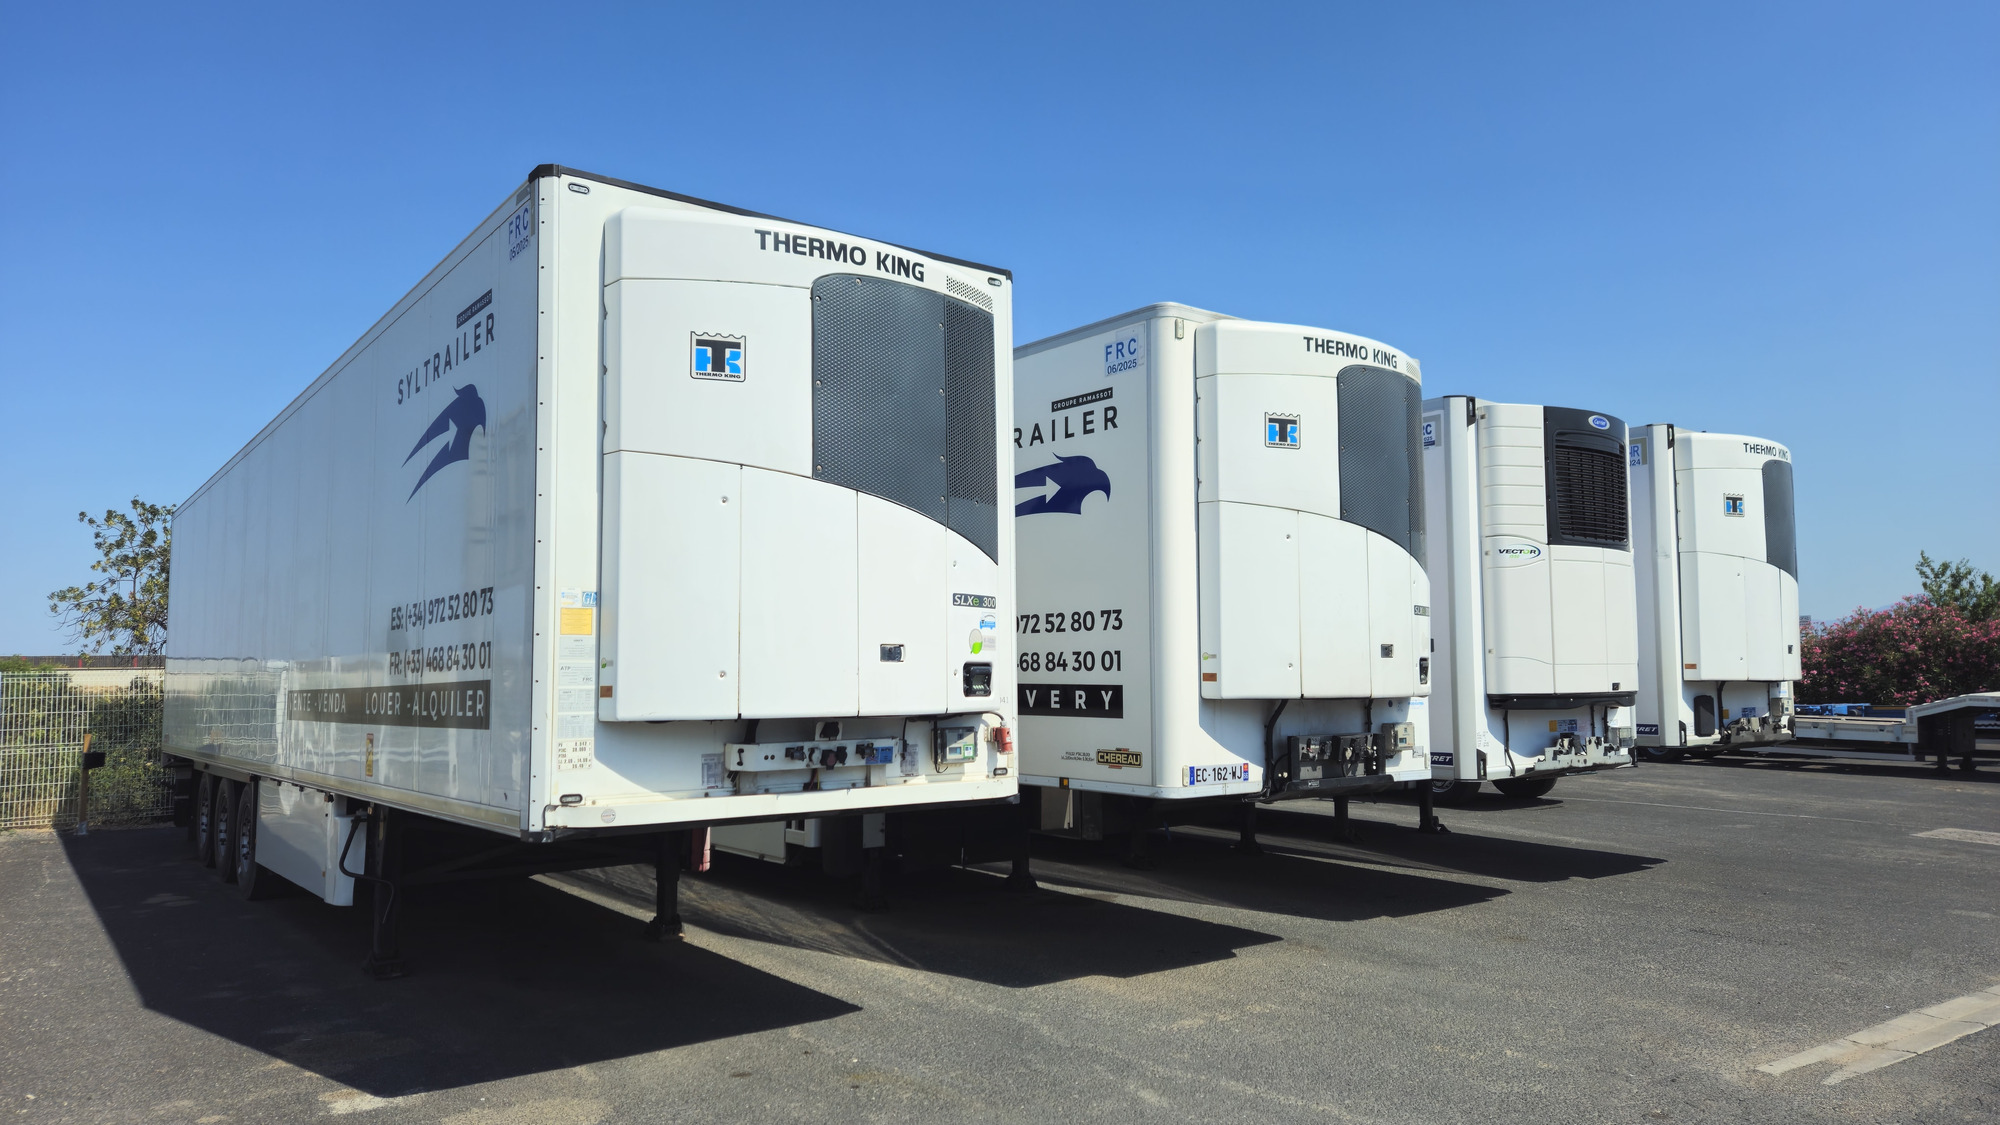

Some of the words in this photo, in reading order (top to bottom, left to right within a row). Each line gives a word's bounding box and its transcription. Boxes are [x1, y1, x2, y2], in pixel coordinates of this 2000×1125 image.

[508, 207, 529, 245] FRC
[754, 228, 867, 266] THERMO
[876, 251, 925, 283] KING
[397, 312, 495, 405] SYLTRAILER
[1104, 337, 1138, 362] FRC
[1303, 336, 1368, 360] THERMO
[1373, 348, 1398, 369] KING
[1106, 358, 1138, 375] 06/2025
[1053, 398, 1077, 410] GROUPE
[1079, 390, 1112, 404] RAMASSOT
[1743, 442, 1777, 457] THERMO
[1778, 448, 1789, 461] KING
[390, 607, 404, 631] ES:
[405, 600, 426, 632] (+34)
[428, 597, 446, 624] 972
[447, 593, 460, 621] 52
[463, 590, 477, 619] 80
[480, 586, 493, 616] 73
[953, 594, 980, 606] SLXe
[982, 597, 996, 608] 300
[1016, 613, 1041, 634] 72
[1044, 612, 1066, 633] 52
[1070, 610, 1095, 632] 80
[1100, 609, 1123, 631] 73
[389, 652, 403, 676] FR:
[404, 647, 424, 678] (+33)
[426, 646, 444, 673] 468
[446, 644, 460, 672] 84
[462, 642, 476, 671] 30
[479, 641, 491, 669] 01
[1016, 651, 1041, 672] 68
[1045, 652, 1068, 672] 84
[1071, 651, 1096, 671] 30
[1100, 650, 1122, 672] 01
[289, 692, 311, 712] VENTE
[365, 691, 401, 715] LOUER
[1098, 752, 1140, 765] CHEREAU
